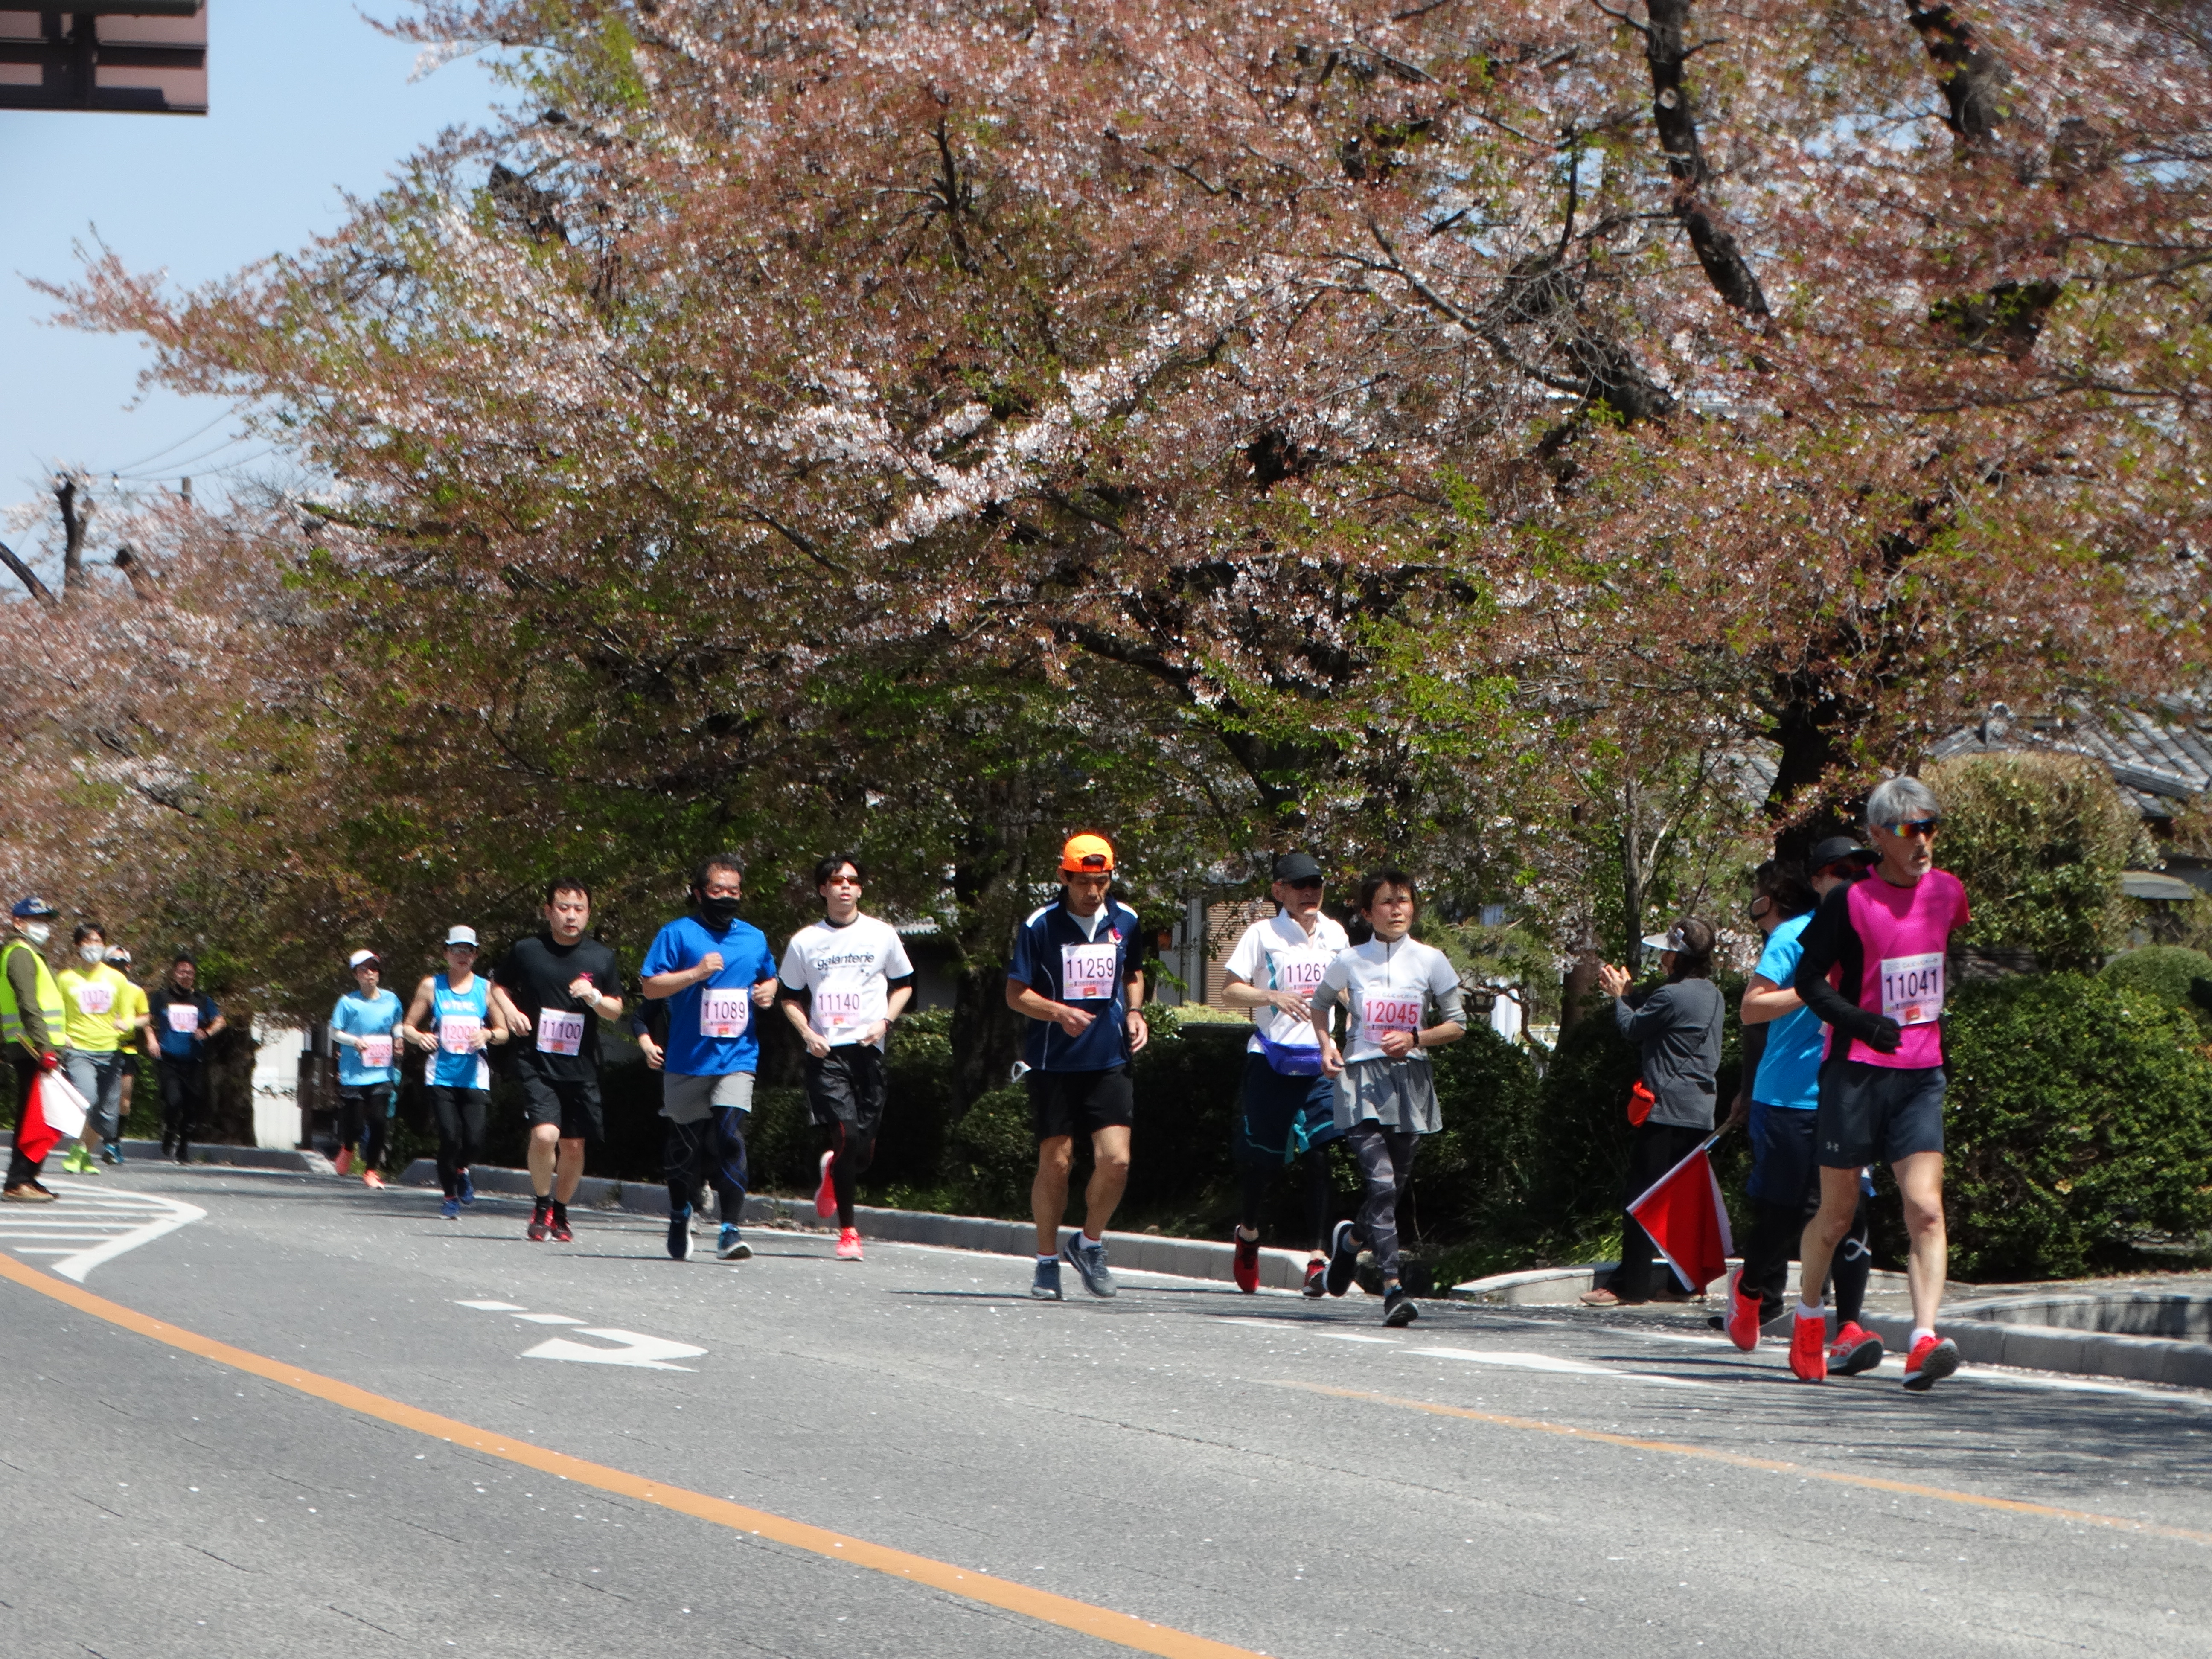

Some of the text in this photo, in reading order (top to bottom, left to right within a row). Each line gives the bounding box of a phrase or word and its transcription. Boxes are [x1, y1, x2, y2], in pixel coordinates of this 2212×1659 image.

[818, 952, 875, 970] galanterie
[1067, 958, 1114, 979] 11259
[1886, 969, 1937, 1001] 11041
[704, 1001, 745, 1019] 11089
[819, 993, 860, 1010] 11140
[1366, 1000, 1420, 1025] 12045
[543, 1020, 581, 1039] 11100
